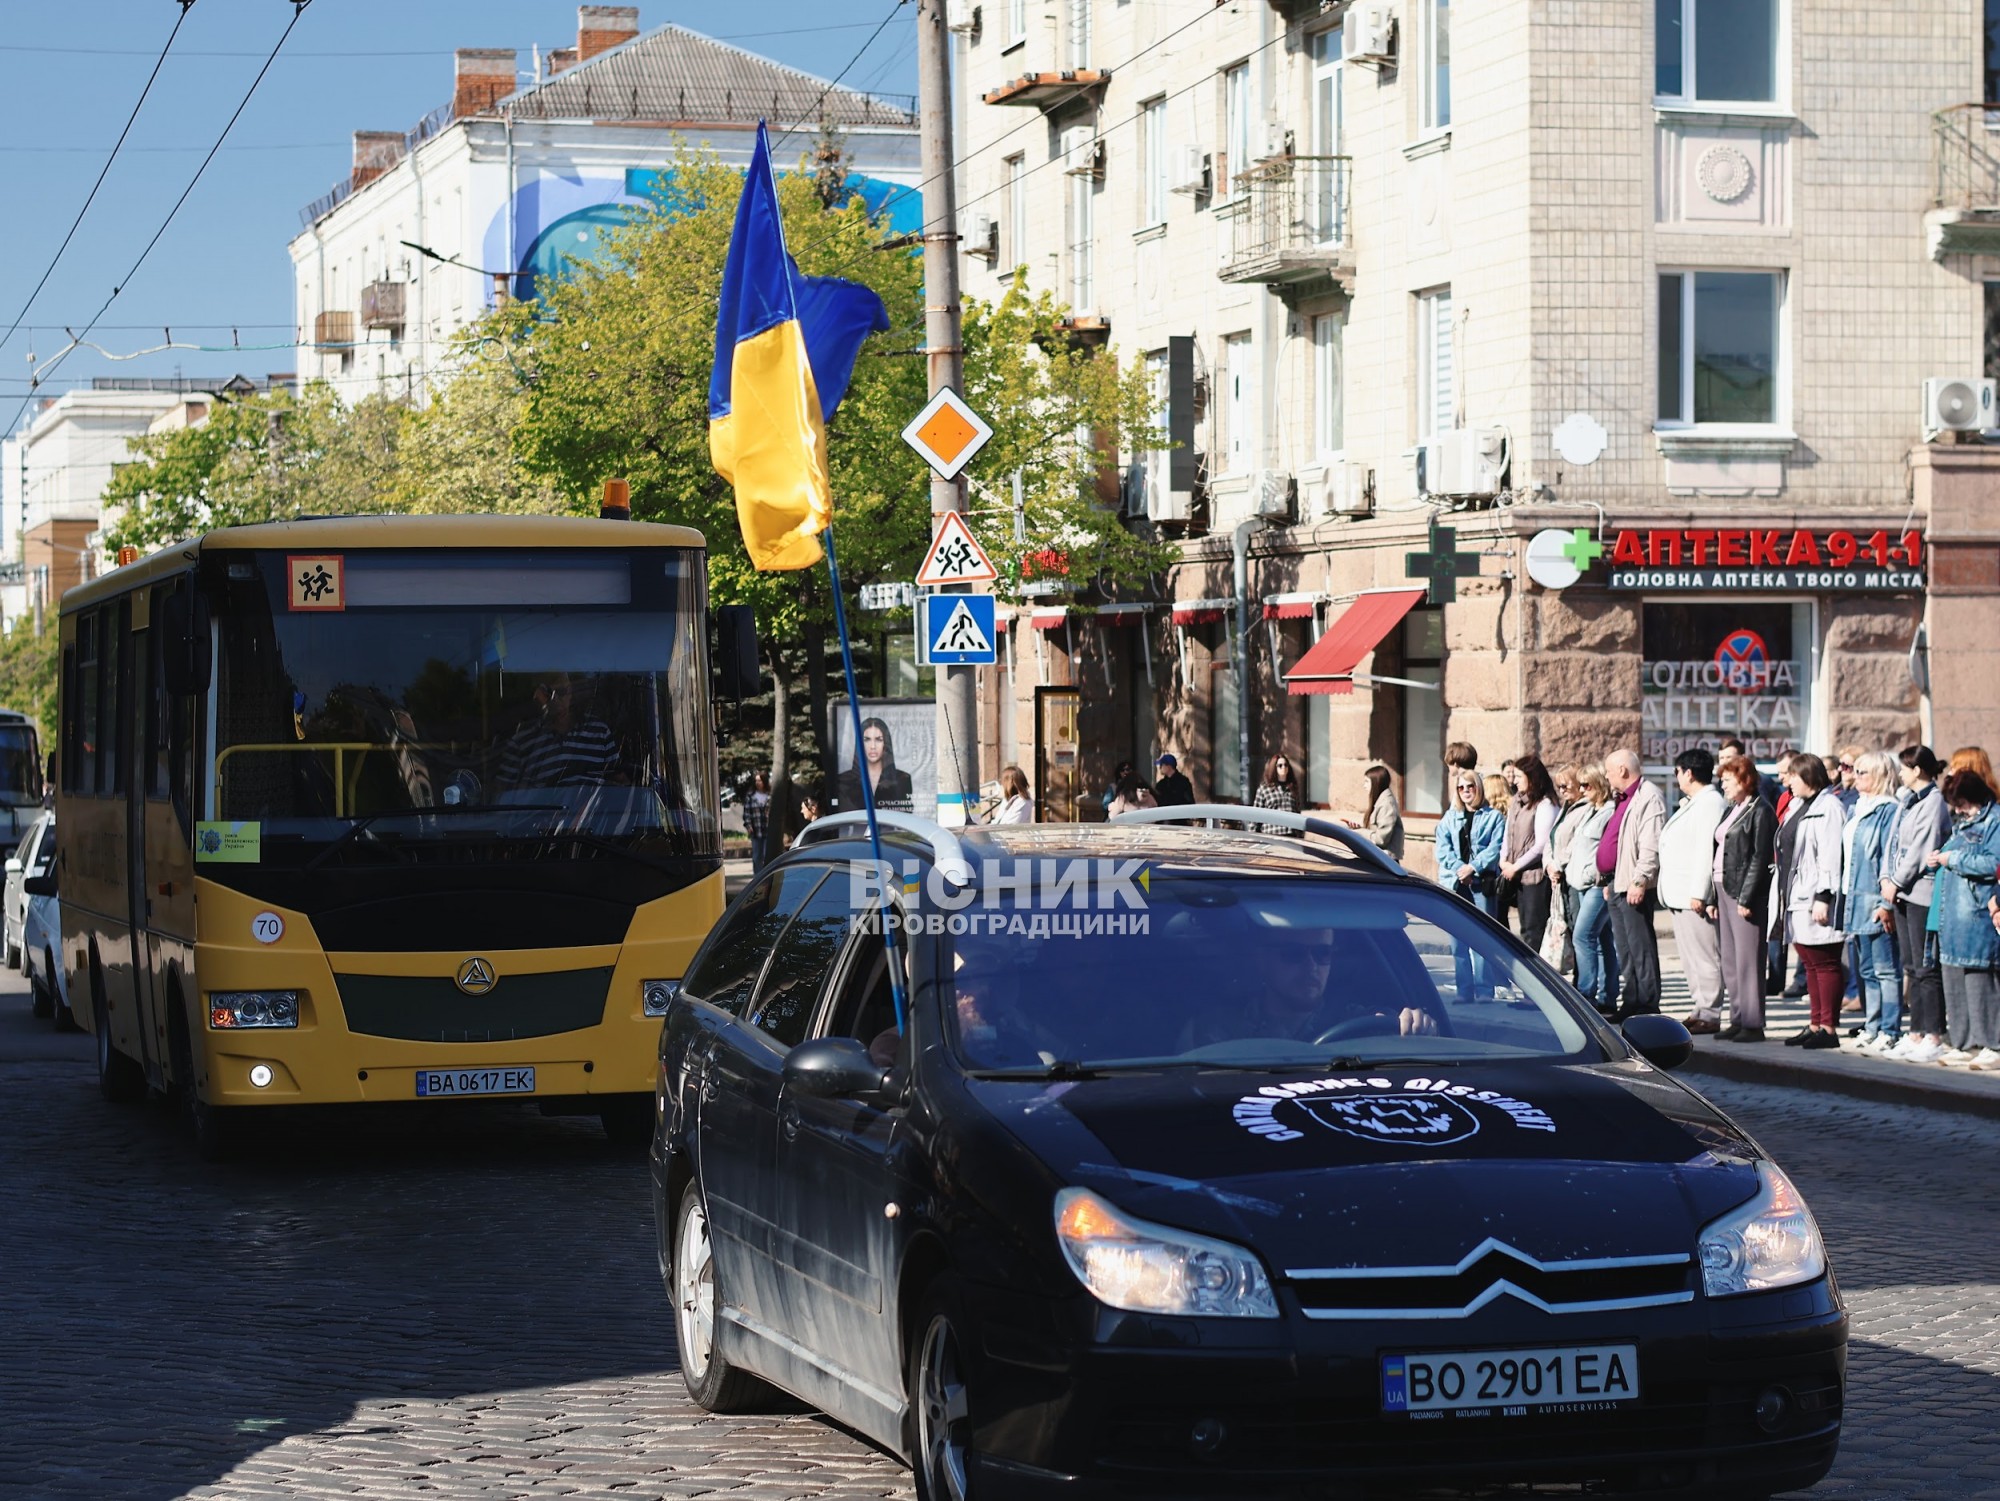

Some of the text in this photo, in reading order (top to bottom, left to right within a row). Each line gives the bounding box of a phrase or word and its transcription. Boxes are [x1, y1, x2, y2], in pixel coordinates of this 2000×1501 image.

[1611, 530, 1821, 567] АПТЕКА
[1613, 573, 1922, 588] ГОЛОВНА АПТЕКА ТВОГО МІСТА
[1645, 660, 1794, 688] ОЛОВНА
[1643, 697, 1796, 728] АПТЕКА
[1643, 738, 1712, 758] ВОГО
[257, 920, 279, 936] 70
[429, 1071, 529, 1092] BA 0617 EK
[1409, 1353, 1630, 1403] BO 2901 EA
[1387, 1390, 1405, 1404] UA
[1410, 1410, 1444, 1420] PADANGOS
[1455, 1408, 1491, 1418] RATLANKIAI
[1538, 1401, 1618, 1414] AUTOSERVISAS
